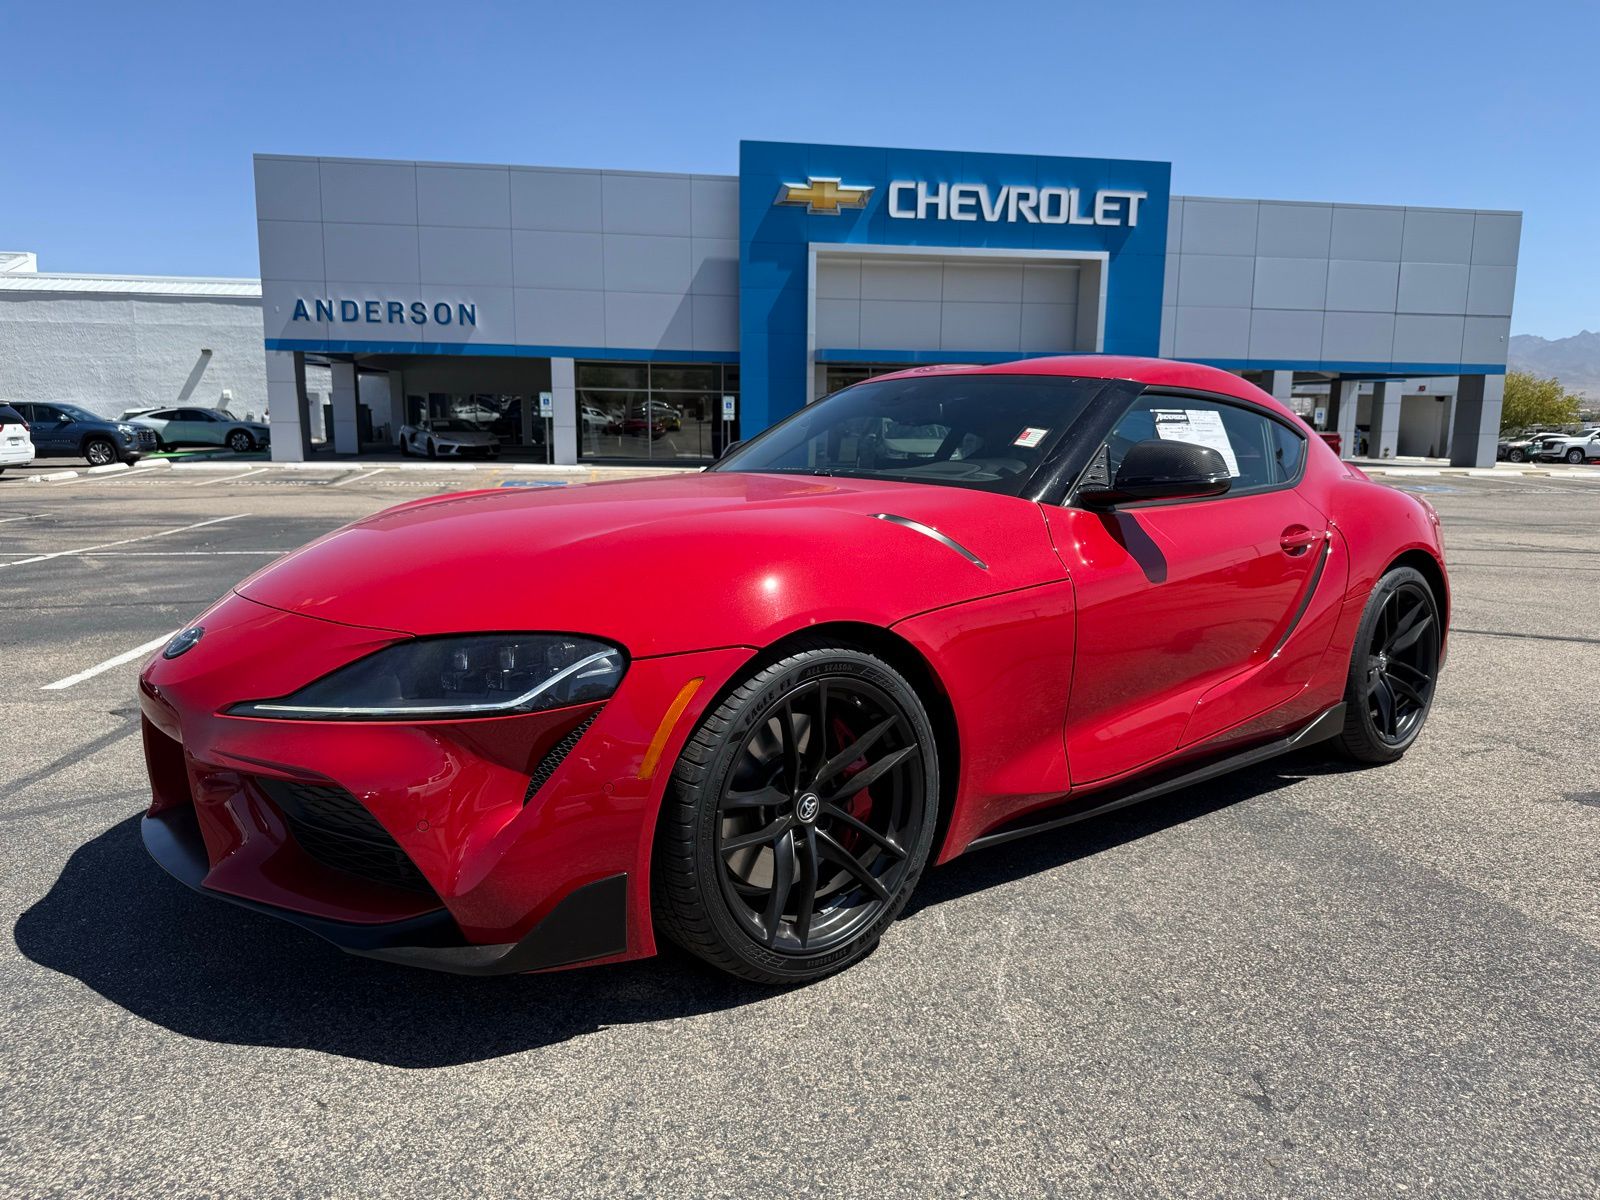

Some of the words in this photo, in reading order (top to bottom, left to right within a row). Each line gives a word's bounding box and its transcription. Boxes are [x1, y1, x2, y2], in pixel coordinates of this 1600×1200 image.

[888, 180, 1148, 227] CHEVROLET
[293, 298, 476, 326] ANDERSON
[807, 667, 820, 676] ALL
[824, 663, 853, 672] SEASON
[745, 691, 775, 725] EAGLE
